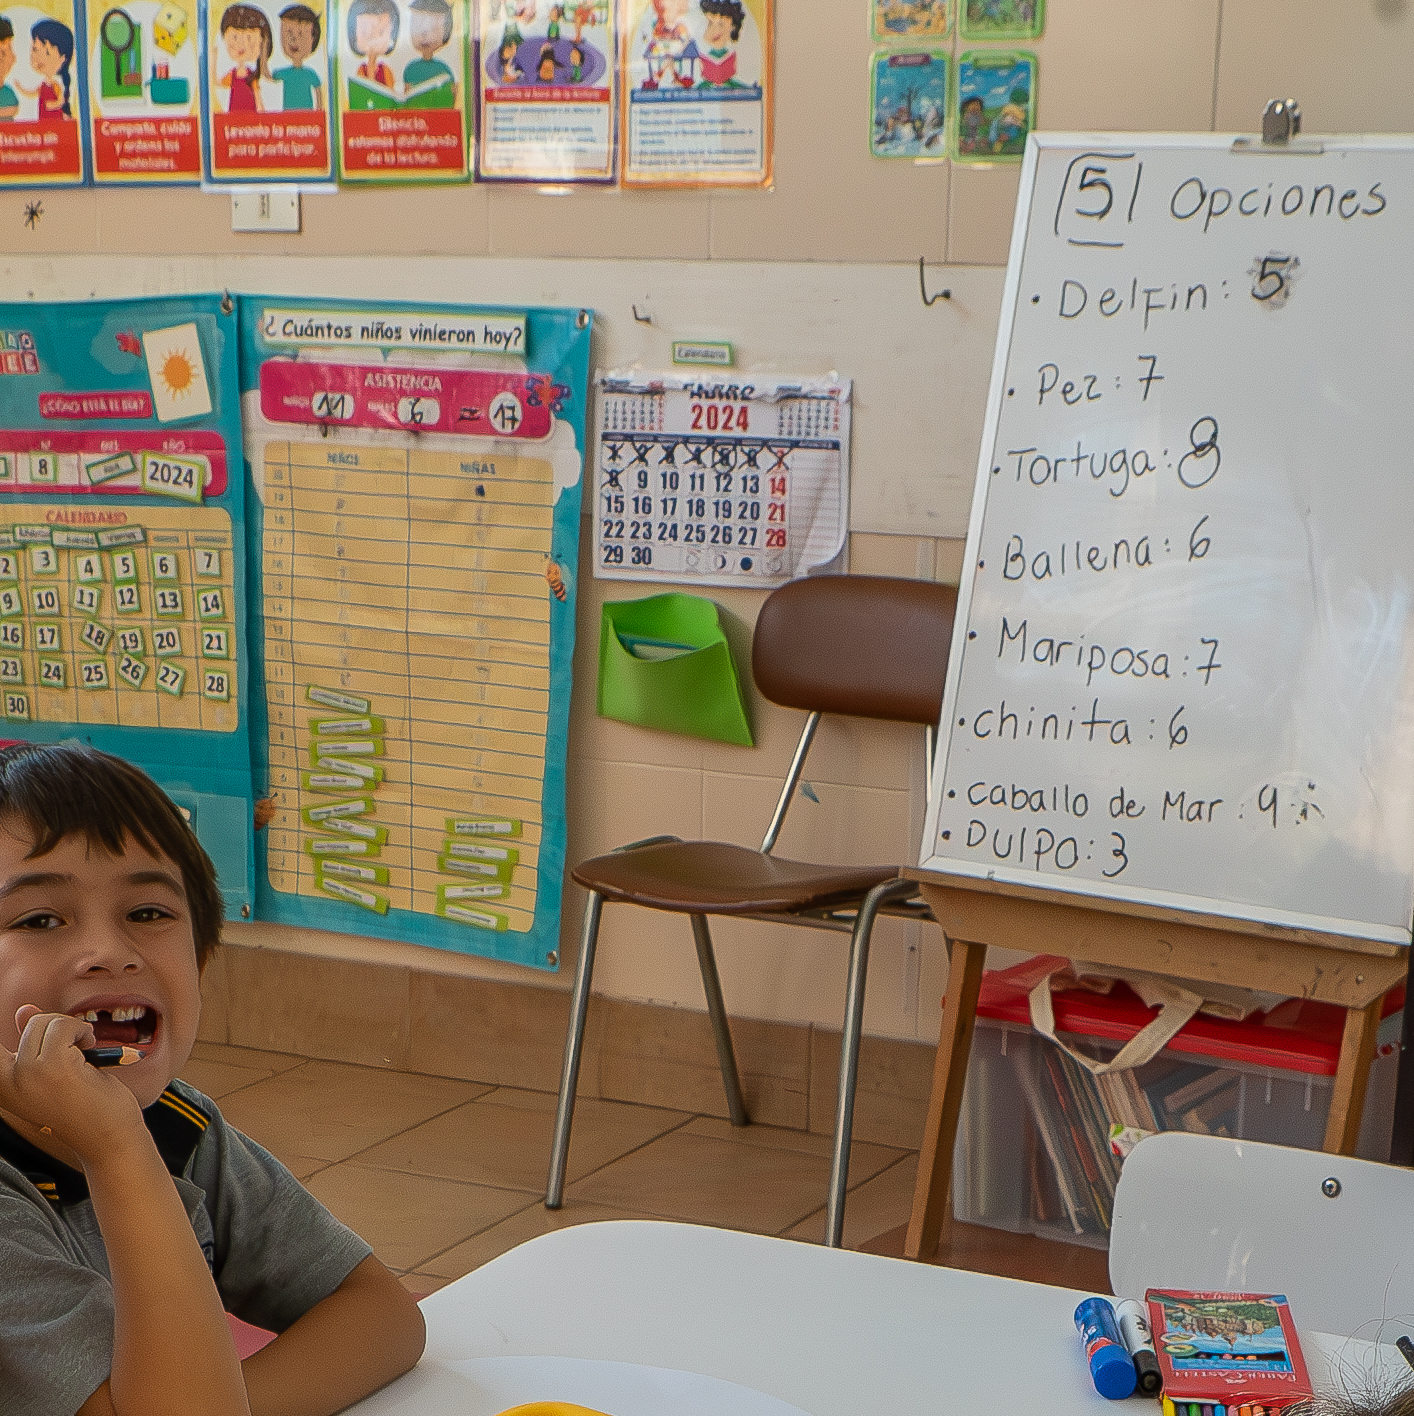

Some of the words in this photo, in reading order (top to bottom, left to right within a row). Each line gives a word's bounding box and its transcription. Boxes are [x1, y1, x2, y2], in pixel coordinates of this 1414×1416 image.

[1075, 167, 1113, 220] 5
[1169, 176, 1388, 233] Opciones
[1251, 256, 1292, 301] 5
[282, 319, 352, 339] Cuántos
[360, 321, 402, 341] niños
[409, 322, 475, 344] vinieron
[484, 323, 521, 350] hoy?
[364, 373, 442, 391] ASISTENCIA
[1137, 353, 1165, 401] 7
[494, 403, 518, 430] 17
[691, 404, 749, 432] 2024
[1177, 415, 1221, 488] 8
[38, 458, 48, 475] 8
[148, 460, 194, 489] 2024
[638, 469, 648, 489] 9
[661, 471, 679, 490] 10
[690, 472, 705, 491] 11
[715, 472, 732, 493] 12
[741, 474, 759, 494] 13
[770, 477, 786, 496] 14
[45, 510, 128, 525] CALENDARIO
[605, 495, 624, 514] 15
[632, 496, 652, 515] 16
[661, 497, 678, 516] 17
[687, 498, 705, 517] 18
[713, 500, 732, 519] 19
[738, 501, 760, 521] 20
[768, 502, 786, 522] 21
[603, 519, 624, 539] 22
[630, 520, 652, 540] 23
[658, 522, 678, 542] 24
[683, 524, 706, 543] 25
[710, 525, 733, 544] 26
[738, 526, 758, 546] 27
[765, 528, 786, 548] 28
[1187, 514, 1211, 562] 6
[1, 557, 10, 574] 2
[40, 551, 50, 567] 3
[84, 559, 94, 575] 4
[121, 557, 130, 573] 5
[159, 556, 168, 573] 6
[203, 552, 213, 569] 7
[603, 545, 623, 564] 29
[631, 546, 652, 565] 30
[3, 592, 13, 608] 9
[37, 591, 55, 608] 10
[77, 587, 94, 607] 11
[118, 588, 134, 605] 12
[158, 591, 179, 609] 13
[199, 594, 220, 612] 14
[2, 626, 19, 643] 16
[39, 627, 55, 644] 17
[87, 624, 105, 646] 18
[121, 633, 138, 649] 19
[155, 631, 176, 648] 20
[205, 633, 223, 651] 21
[1, 658, 19, 676] 23
[42, 663, 61, 680] 24
[84, 663, 103, 682] 25
[121, 657, 140, 680] 26
[158, 666, 180, 687] 27
[206, 674, 224, 693] 28
[1196, 637, 1223, 685] 7
[8, 696, 24, 713] 30
[1168, 705, 1189, 750] 6
[1108, 785, 1147, 818] de
[1258, 784, 1279, 829] 9
[1102, 831, 1130, 877] 3
